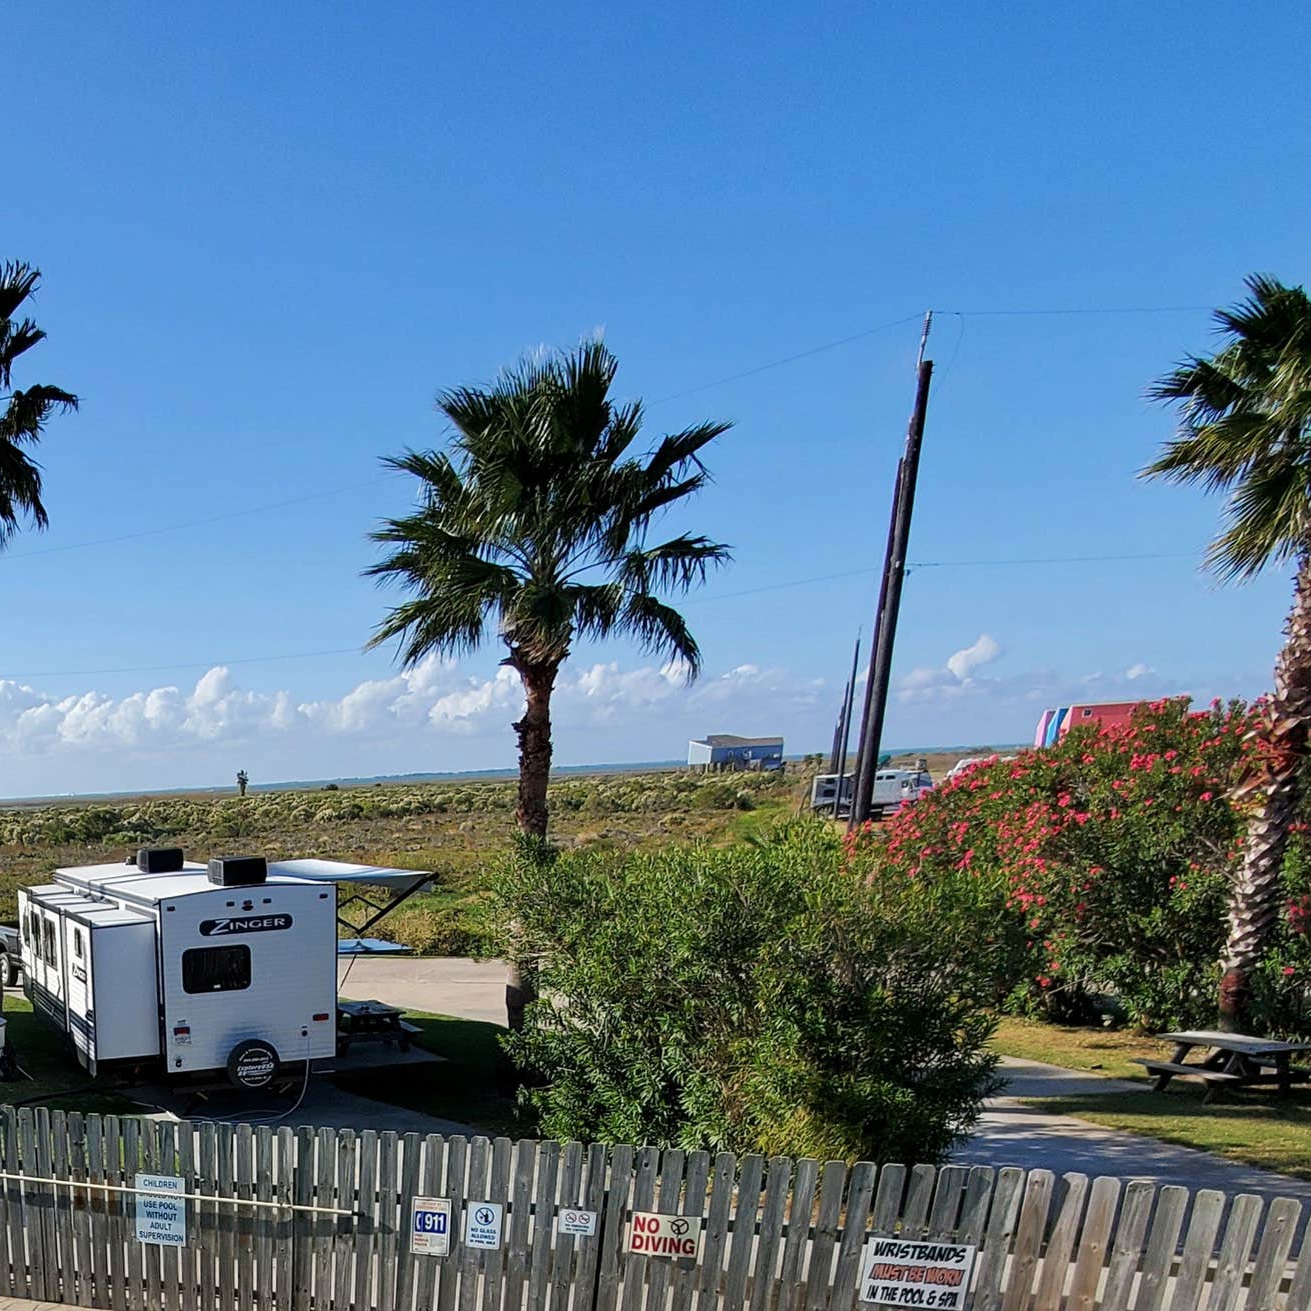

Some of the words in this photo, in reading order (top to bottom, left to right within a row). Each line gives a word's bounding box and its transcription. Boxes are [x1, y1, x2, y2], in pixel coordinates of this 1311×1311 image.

[210, 918, 285, 935] ZINGER
[143, 1179, 178, 1189] CHILDREN
[143, 1200, 157, 1208] USE
[159, 1201, 177, 1210] POOL
[146, 1210, 177, 1221] WITHOUT
[425, 1213, 444, 1231] 911
[150, 1221, 172, 1230] ADULT
[634, 1216, 660, 1234] NO
[139, 1230, 183, 1242] SUPERVISION
[632, 1234, 695, 1255] DIVING
[873, 1241, 967, 1263] WRISTBANDS
[869, 1263, 908, 1281] MUST
[905, 1265, 926, 1283] BE
[924, 1266, 966, 1287] WORN
[866, 1284, 879, 1300] IN
[880, 1286, 899, 1301] THE
[898, 1287, 924, 1304] POOL
[926, 1290, 937, 1306] &
[938, 1291, 959, 1307] SPA
